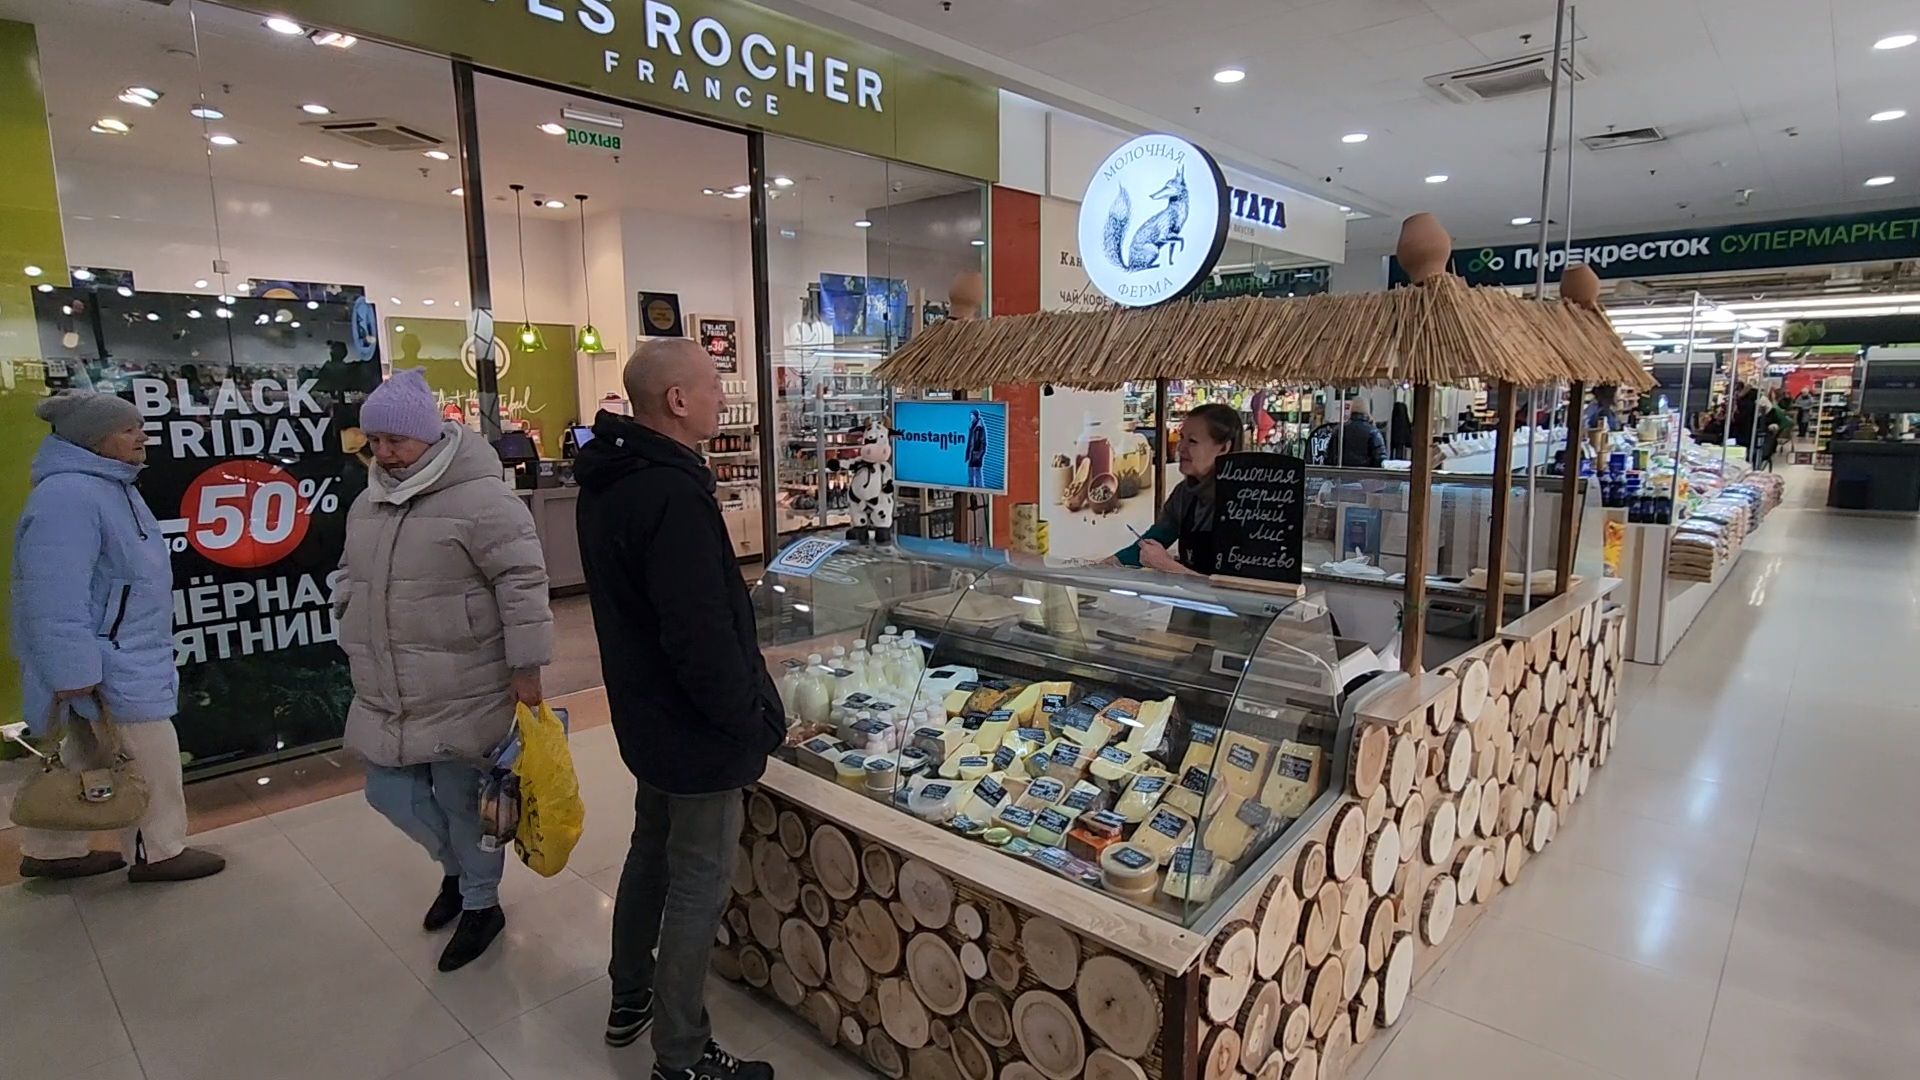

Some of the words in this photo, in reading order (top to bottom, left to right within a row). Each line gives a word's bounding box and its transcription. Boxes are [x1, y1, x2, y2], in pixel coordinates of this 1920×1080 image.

[645, 0, 883, 113] ROCHER
[604, 50, 779, 115] FRANCE
[1103, 143, 1186, 181] МОЛОЧНАЯ
[1060, 251, 1083, 268] Кан
[1117, 276, 1174, 298] ФЕРМА
[132, 378, 324, 417] BLACK
[142, 417, 331, 459] FRIDAY
[895, 429, 966, 451] Konstantin
[1216, 460, 1300, 484] Молочная
[1236, 487, 1296, 509] ферма
[171, 609, 340, 667] ЯТНИЦ
